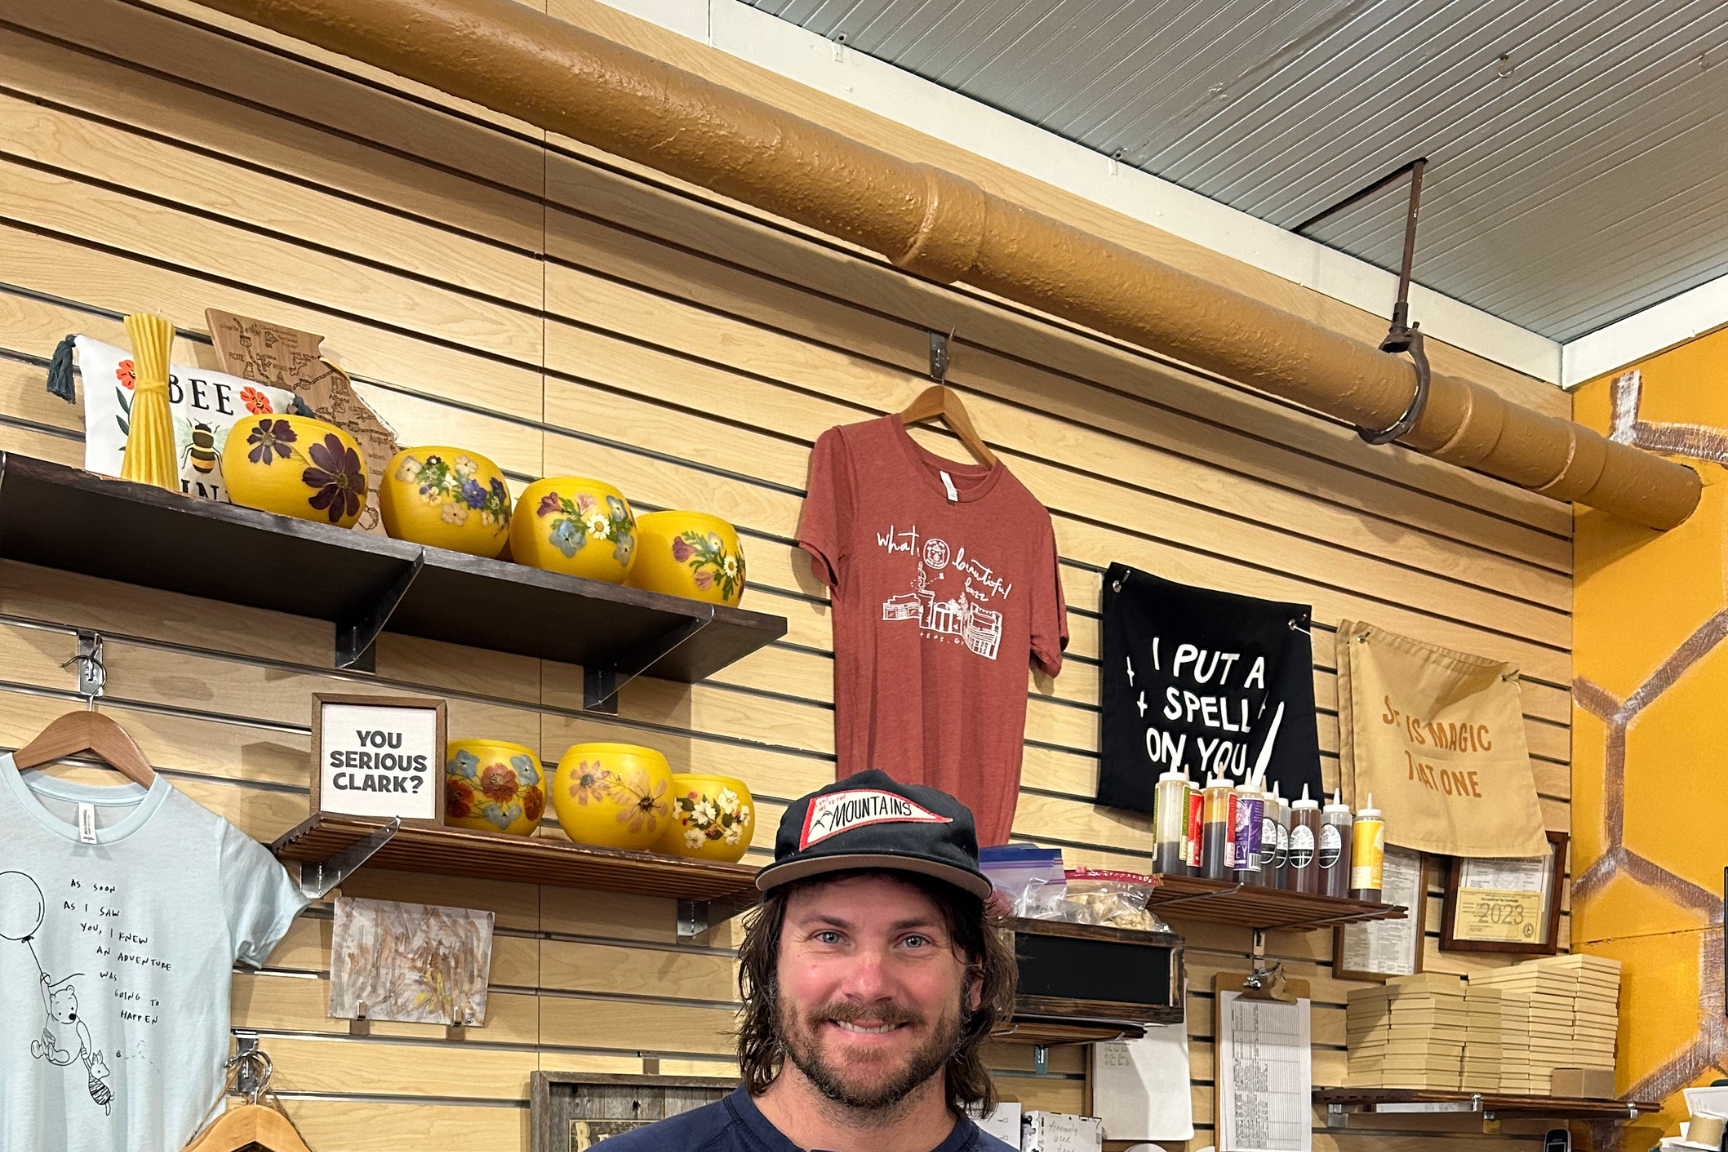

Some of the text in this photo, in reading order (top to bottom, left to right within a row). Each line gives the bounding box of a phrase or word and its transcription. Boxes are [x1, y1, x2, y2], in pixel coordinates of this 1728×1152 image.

[169, 374, 234, 416] BEE
[952, 547, 1012, 599] beautiful
[1152, 637, 1265, 689] I PUT A
[1163, 686, 1251, 733] SPELL
[356, 730, 402, 749] YOU
[1406, 715, 1426, 745] IS
[1428, 722, 1492, 753] MAGIC
[330, 750, 428, 772] SERIOUS
[1146, 727, 1247, 776] ON YOU
[333, 772, 424, 794] CLARK?
[1440, 769, 1482, 798] ONE
[829, 795, 913, 832] MOUNTAINS
[93, 884, 116, 893] SOON
[84, 903, 88, 912] I
[100, 907, 121, 917] SAW
[1478, 903, 1524, 925] 2023
[110, 928, 114, 938] I
[118, 931, 149, 944] KNEW
[96, 946, 173, 972] AN ADVENTURE
[99, 971, 118, 982] WAS
[114, 989, 160, 1007] GOING TO
[120, 1010, 159, 1026] HAPPEN
